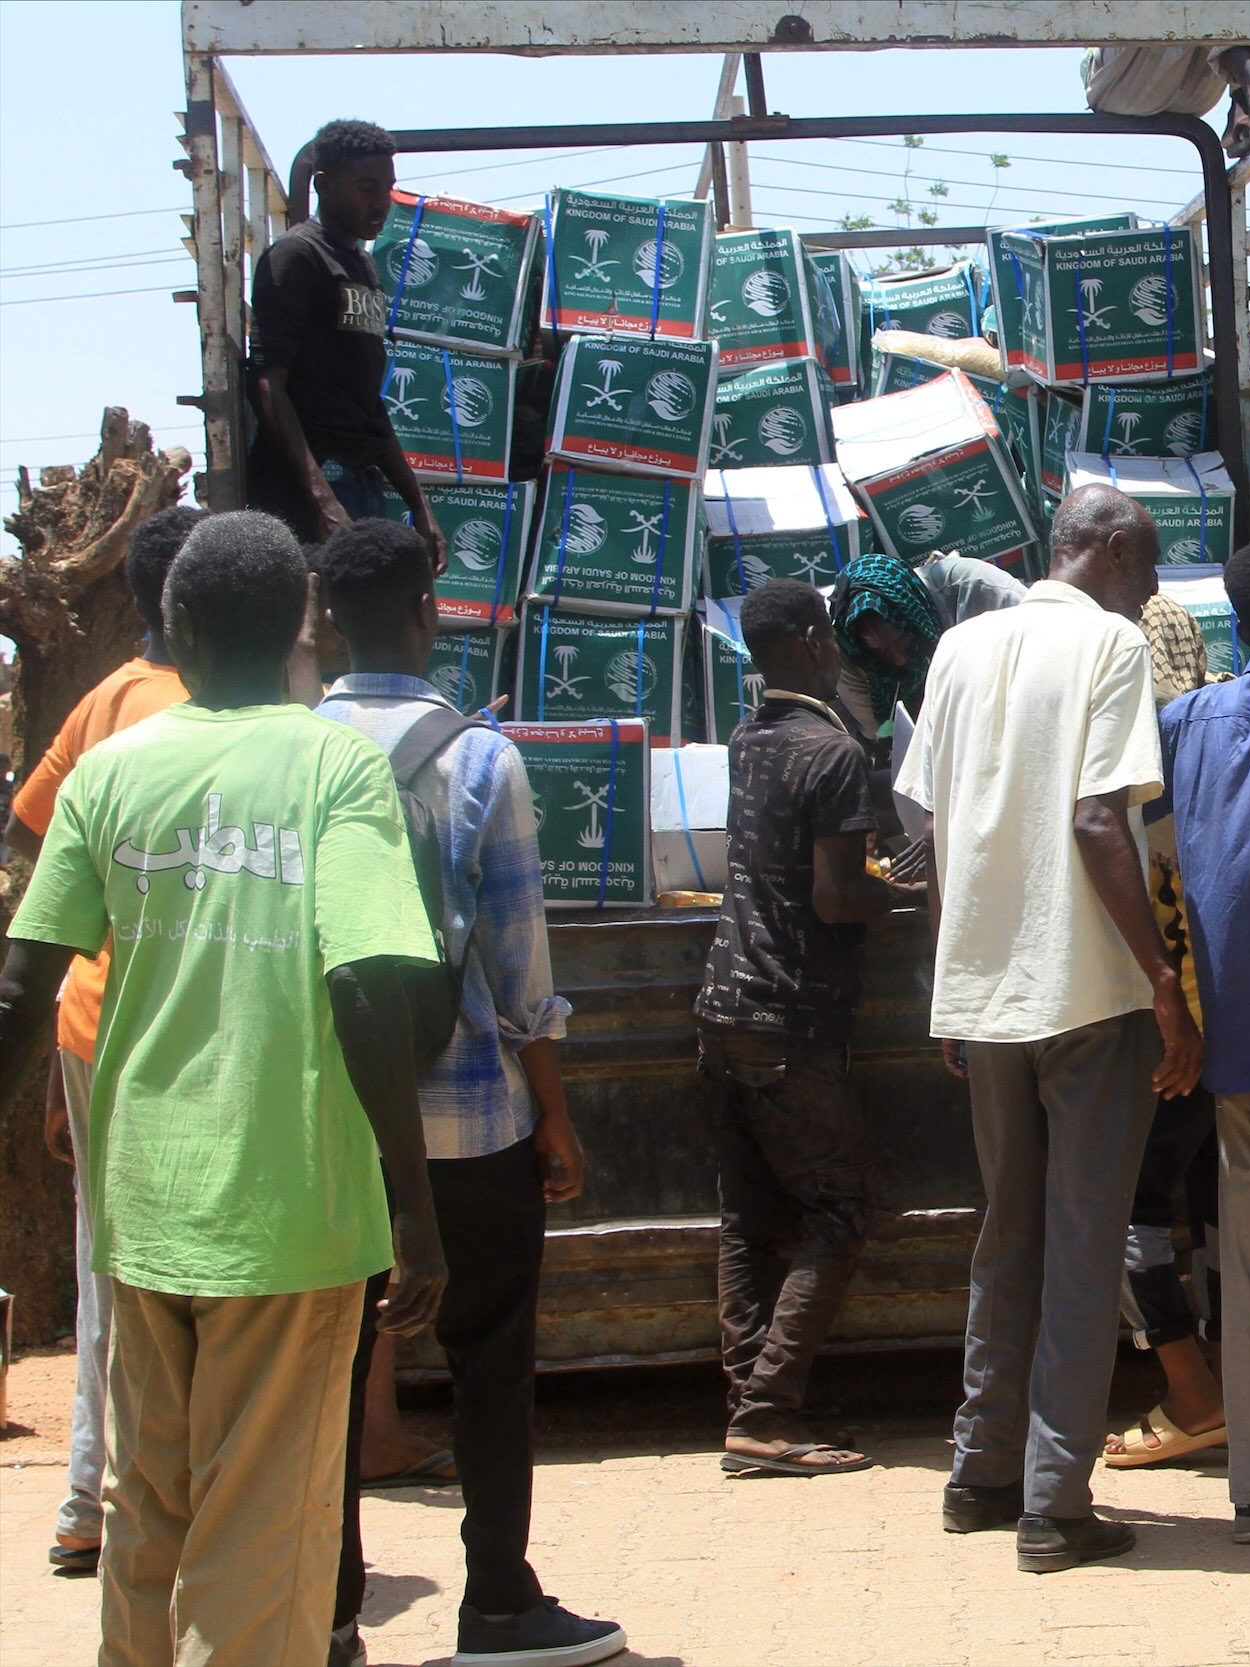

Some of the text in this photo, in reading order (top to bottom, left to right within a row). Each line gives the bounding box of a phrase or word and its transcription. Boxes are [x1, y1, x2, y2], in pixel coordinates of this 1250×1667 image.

[567, 193, 616, 209] السعودية
[619, 201, 654, 214] العربية
[565, 208, 610, 221] KINGDOM
[613, 214, 625, 222] OF
[628, 217, 657, 226] SAUDI
[718, 238, 788, 254] المملكة العربية
[1055, 240, 1183, 259] الملكة العربية السودية
[716, 250, 789, 266] OF SAUDI ARABIA
[1056, 260, 1100, 270] KINGDOM
[1103, 259, 1116, 267] OF
[1119, 255, 1148, 266] SAUDI
[344, 287, 384, 322] BOS
[911, 297, 938, 307] SAUDI
[939, 290, 970, 302] ARABIA
[410, 300, 440, 311] SAUDI
[577, 315, 598, 324] يباع
[451, 319, 501, 337] السعودية
[387, 349, 416, 358] GDOM
[419, 352, 432, 360] OF
[465, 361, 502, 369] ARABIA
[585, 342, 626, 352] KINGDOM
[643, 349, 670, 358] SAUDI
[671, 352, 705, 364] ARABIA
[740, 352, 761, 360] مجانا
[762, 349, 784, 359] يوزع
[1120, 362, 1144, 371] مجانا
[1144, 361, 1167, 370] يوزع
[734, 378, 765, 390] العربية
[766, 373, 802, 385] المملكة
[745, 390, 771, 400] SAUDI
[772, 385, 804, 396] ARABIA
[1098, 390, 1214, 403] KIGDOM OF SAUDI ARAA
[587, 445, 609, 453] يباع
[623, 449, 647, 461] مجانا
[424, 457, 448, 468] مجانا
[650, 455, 671, 466] يوزع
[432, 495, 445, 504] OF
[448, 497, 478, 507] SAUDI
[479, 500, 517, 511] ARABA
[1182, 506, 1224, 515] الملكة
[1155, 519, 1223, 527] SAUDI ARBIA
[979, 520, 1017, 539] KINGDOM
[967, 534, 977, 543] OF
[939, 539, 965, 551] SAUDI
[582, 568, 612, 577] SAUDI
[615, 572, 628, 580] OF
[631, 573, 675, 585] KINDOM
[542, 576, 675, 599] الملكة العربية السعدية
[458, 605, 482, 615] يوزع
[533, 614, 667, 628] الممكة العربية السعوية
[1200, 621, 1215, 630] UDI
[533, 626, 580, 636] KGDOM
[582, 627, 594, 636] OF
[630, 630, 667, 640] AABIA
[433, 642, 451, 651] UDI
[578, 728, 604, 738] يباع
[112, 793, 304, 895] الطيب
[559, 861, 575, 871] OF
